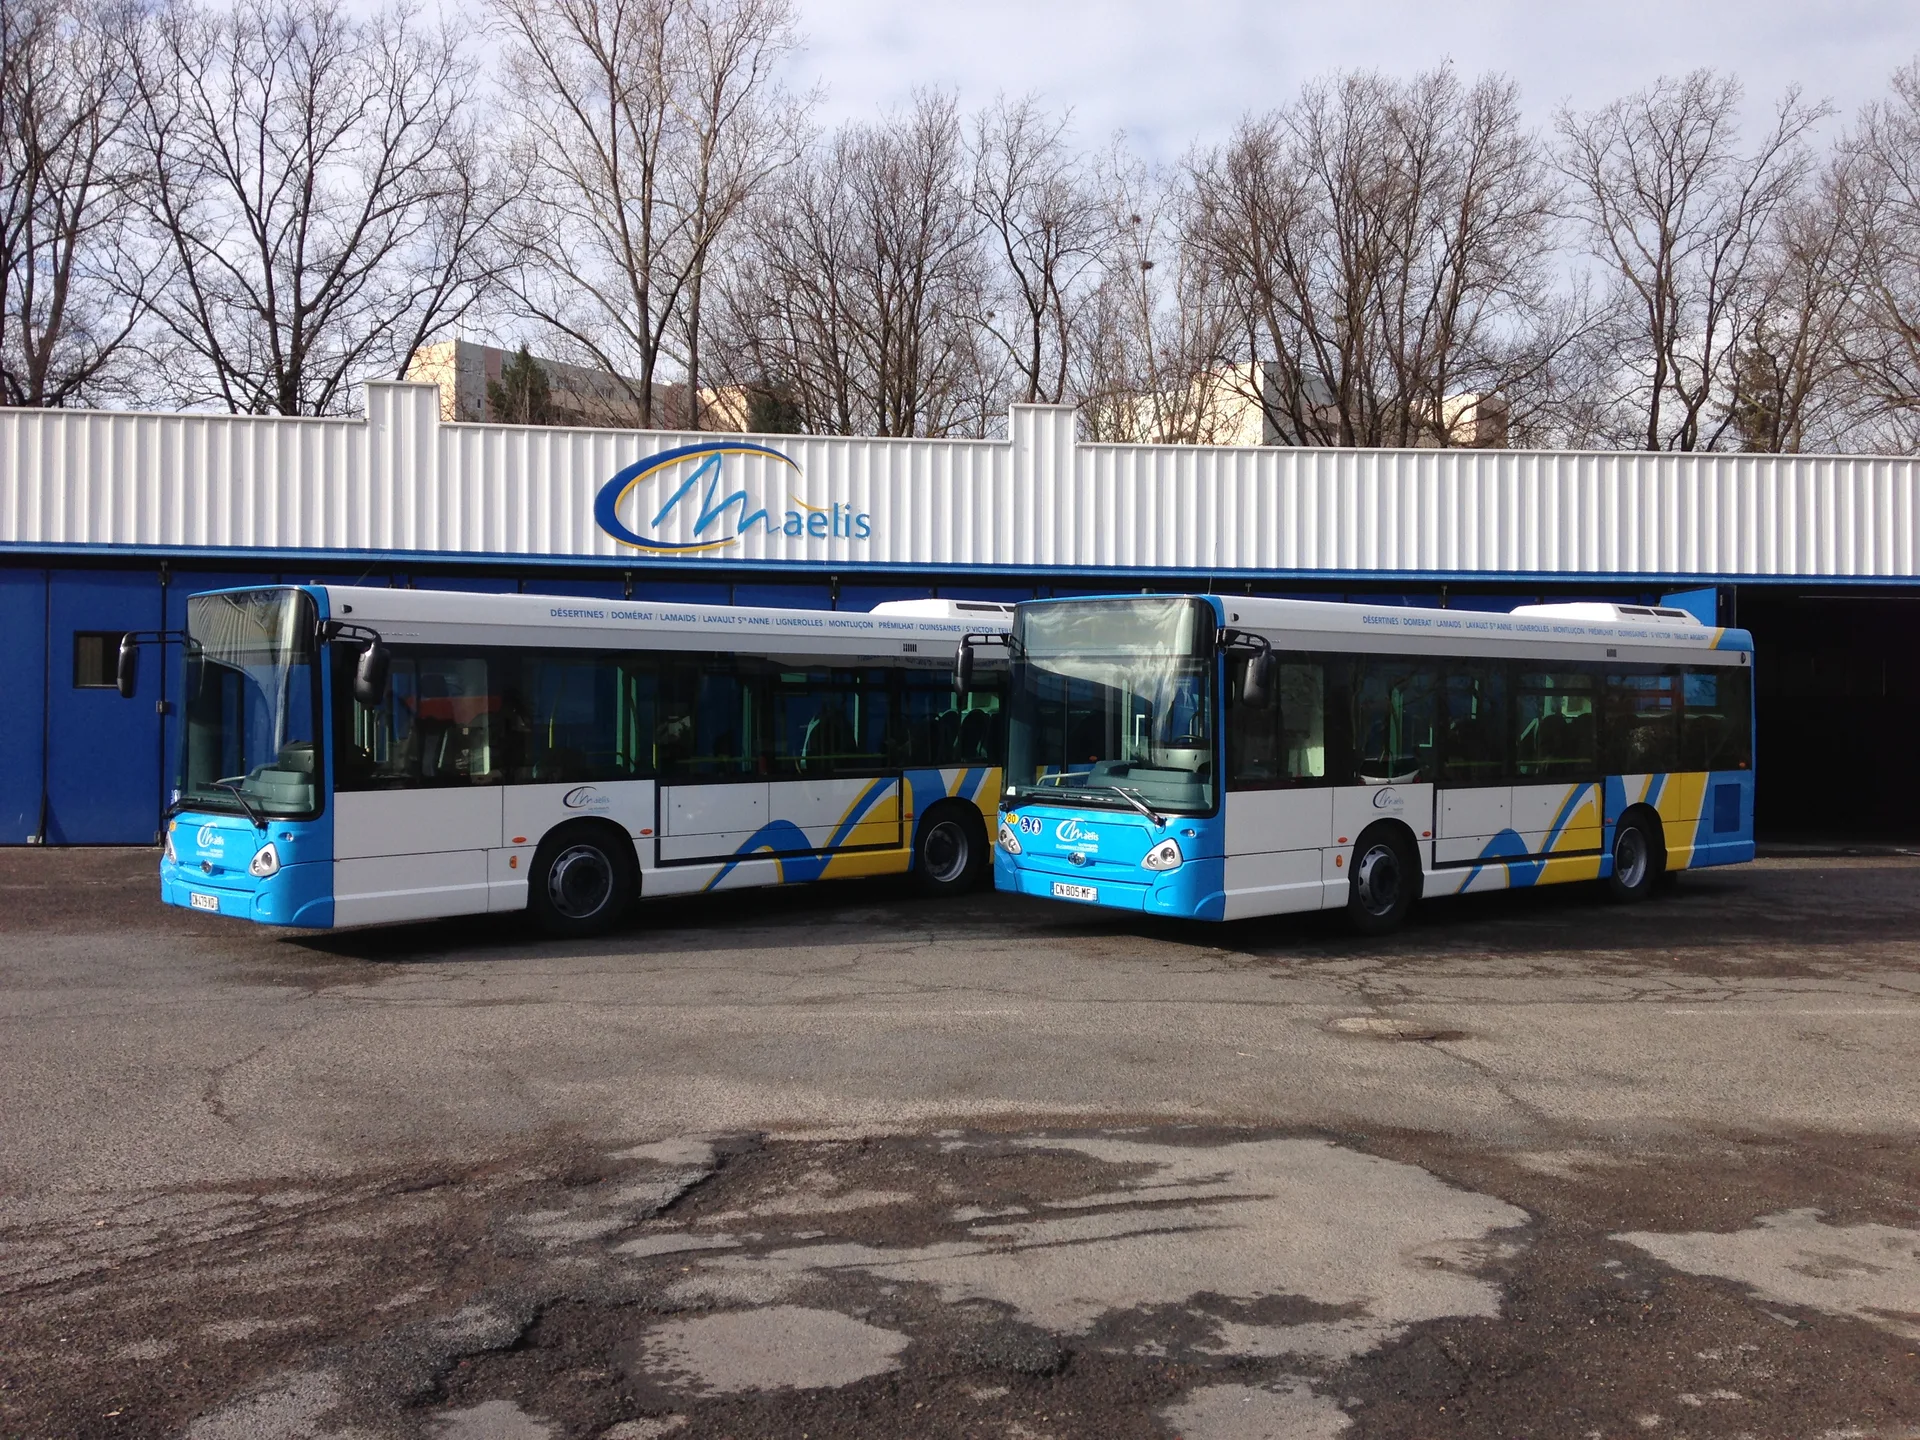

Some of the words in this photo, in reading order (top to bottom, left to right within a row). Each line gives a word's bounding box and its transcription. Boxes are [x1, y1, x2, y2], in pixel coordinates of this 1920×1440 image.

[650, 450, 872, 541] Maelis
[550, 608, 604, 619] DÉSERTINES
[611, 610, 653, 621] DOMÉRAT
[660, 613, 697, 622] LAMAIDS
[703, 615, 736, 624] LAVAULT
[748, 617, 770, 625] ANNE
[776, 618, 823, 627] LIGNEROLLES
[829, 620, 874, 629] MONTLUÇON
[878, 621, 914, 630] PRÉMILHAT
[919, 623, 961, 632] QUINSSAINES
[972, 626, 994, 634] VICTOR
[1363, 615, 1398, 625] DÉSERTINES
[1437, 620, 1462, 629] LAMAIDS
